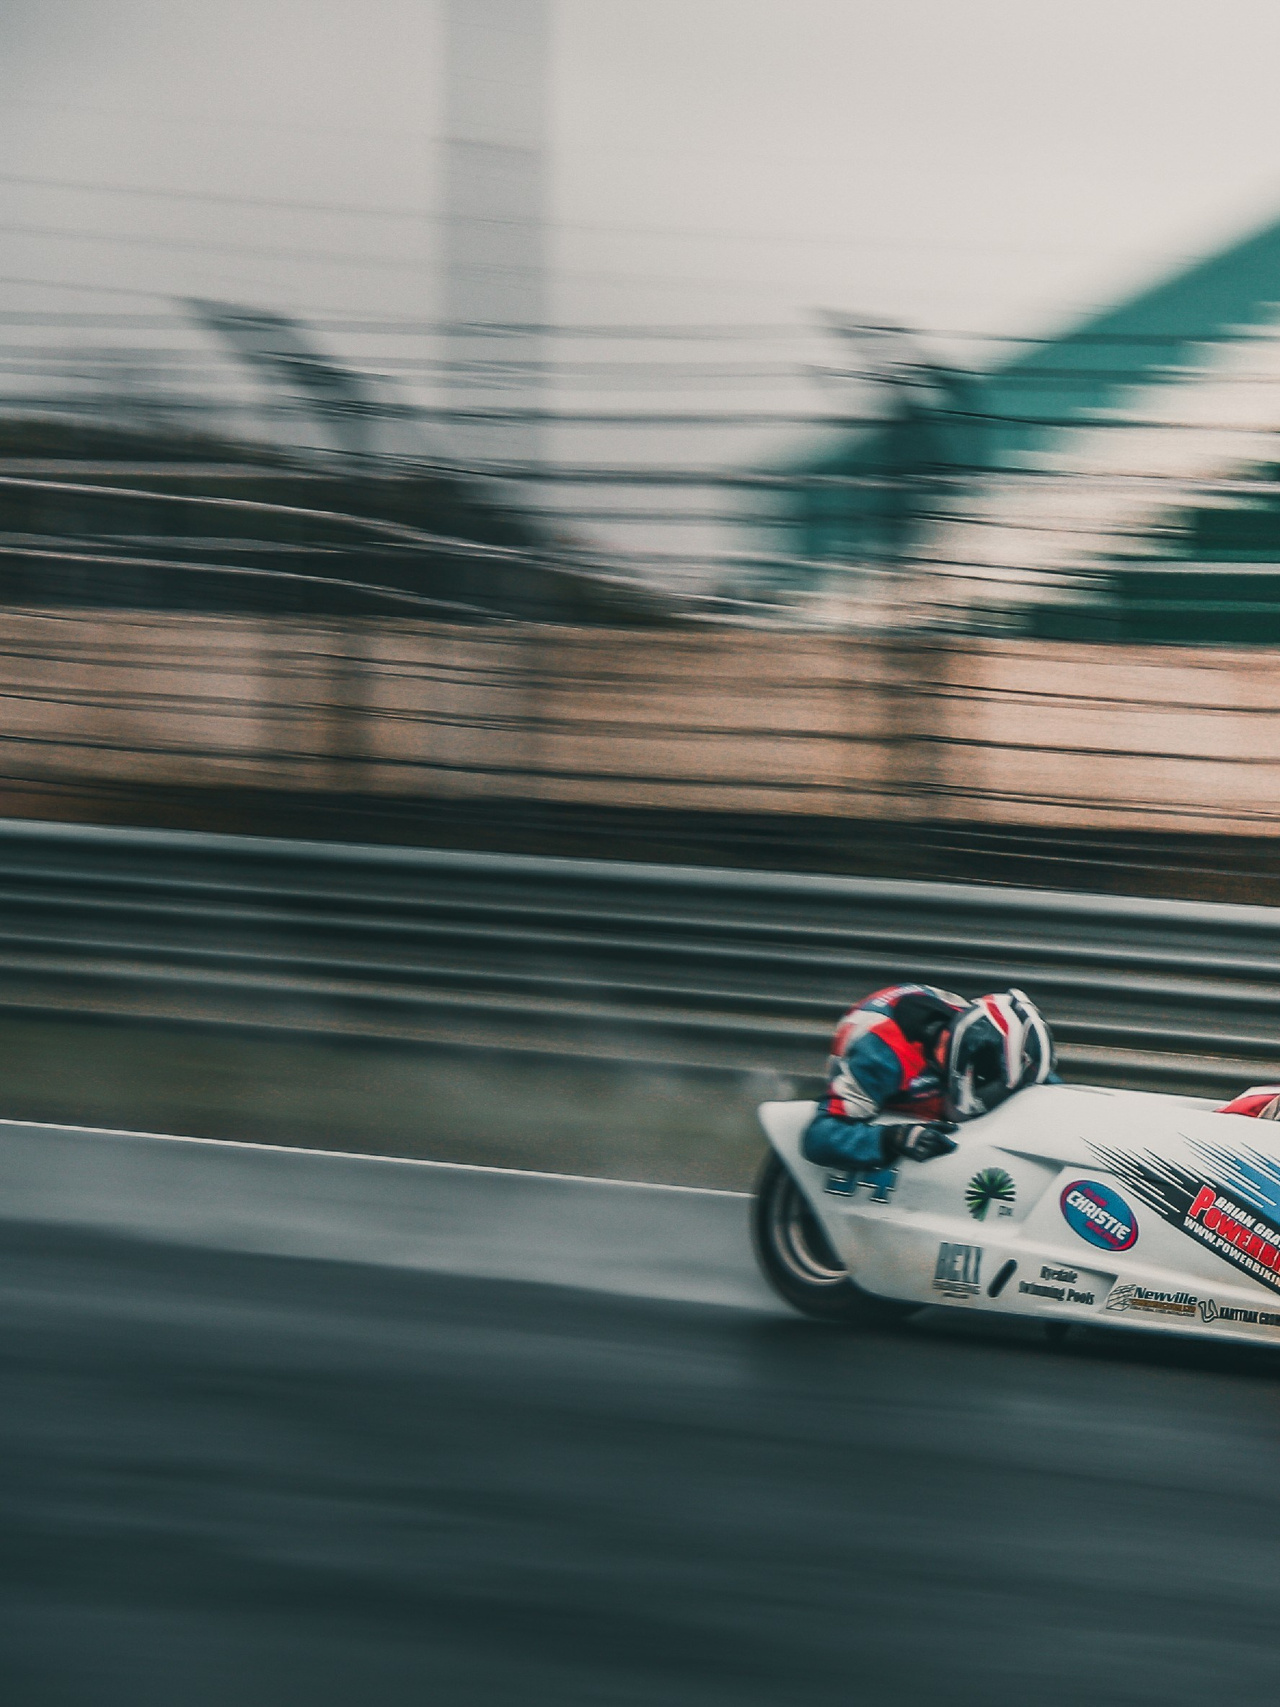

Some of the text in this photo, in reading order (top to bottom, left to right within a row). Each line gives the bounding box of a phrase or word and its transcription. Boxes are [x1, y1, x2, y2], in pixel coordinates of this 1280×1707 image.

[1066, 1190, 1132, 1240] CHRISTIE
[1214, 1196, 1257, 1227] BRIAN
[1066, 1288, 1095, 1305] Pools
[1134, 1286, 1199, 1306] Newville
